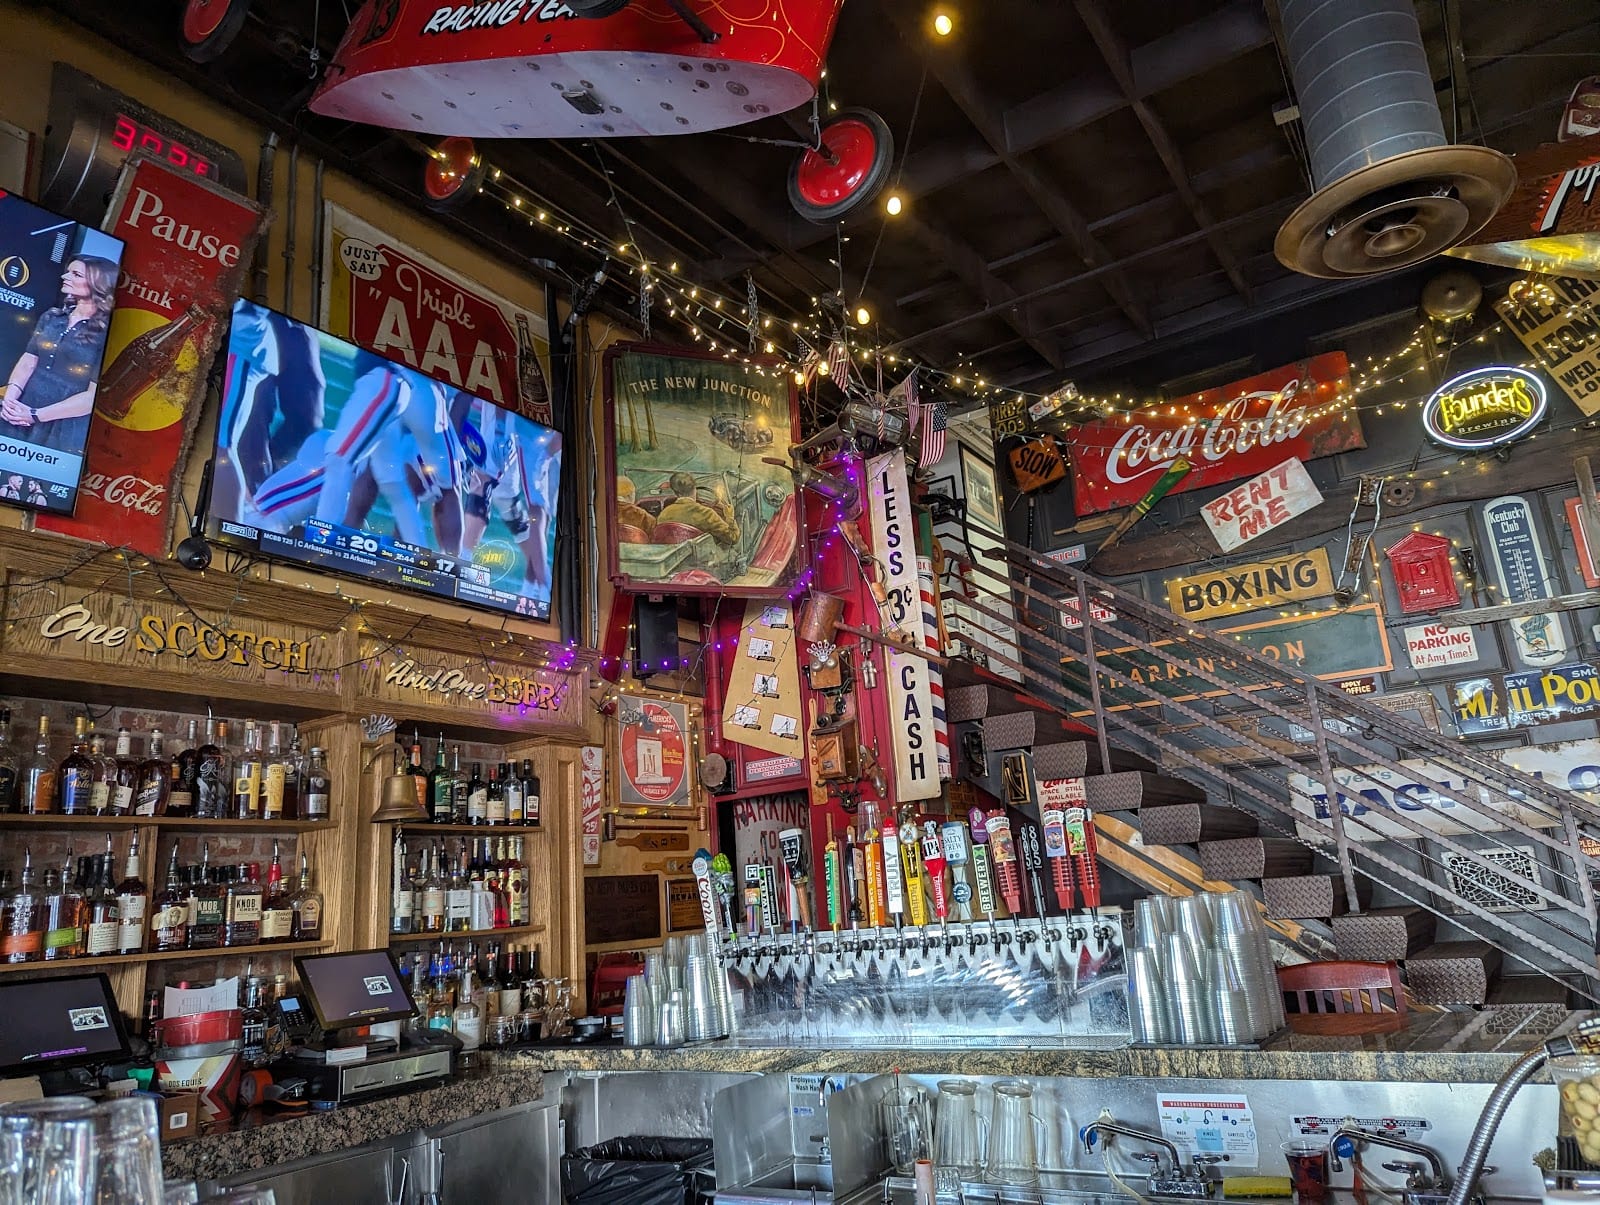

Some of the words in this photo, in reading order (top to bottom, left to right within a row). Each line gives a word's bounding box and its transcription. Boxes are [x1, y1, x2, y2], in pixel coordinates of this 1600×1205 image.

[424, 0, 524, 33] RACING
[523, 0, 578, 21] TEA
[125, 187, 240, 267] Pause
[343, 246, 380, 263] JUST
[350, 261, 377, 275] SAY
[0, 292, 35, 310] AYOFF
[396, 263, 475, 330] Triple
[629, 378, 658, 395] THE
[665, 375, 696, 389] NEW
[703, 378, 771, 408] JUNCTION
[1441, 378, 1532, 432] Founders
[0, 443, 59, 465] oodyear
[1015, 447, 1058, 480] SLOW
[80, 474, 167, 516] a-Cola
[1205, 463, 1294, 527] RENT
[309, 519, 333, 530] KANSAS
[881, 471, 904, 576] LESS
[1238, 496, 1292, 540] ME
[1488, 506, 1525, 524] Kentucky
[1500, 520, 1520, 534] Club
[304, 542, 334, 556] Arkansas
[350, 554, 377, 566] Arkansas
[350, 535, 378, 553] 20
[436, 557, 456, 572] 17
[1180, 558, 1318, 613] BOXING
[887, 585, 913, 624] 3¢
[41, 603, 128, 647] One
[136, 615, 311, 673] SCOTCH
[1408, 632, 1472, 652] PARKING
[1423, 624, 1449, 637] NO
[1415, 654, 1426, 665] At
[1427, 653, 1447, 665] Any
[1449, 645, 1473, 660] Time!
[385, 659, 438, 692] And
[438, 669, 487, 699] One
[488, 673, 560, 711] BEER
[1340, 680, 1361, 689] APPLY
[902, 665, 926, 780] CASH
[1307, 769, 1392, 788] Pyer's
[1040, 788, 1060, 796] SPACE
[1064, 785, 1083, 793] STILL
[1047, 791, 1082, 800] AVAILABLE
[733, 795, 808, 831] PARKING
[922, 841, 940, 857] IPA
[1029, 825, 1042, 866] 805
[885, 853, 901, 902] TRULY
[975, 858, 992, 911] BREWERY
[198, 900, 218, 911] KNOB
[236, 898, 256, 908] KNOB
[698, 877, 714, 927] Coors
[168, 1079, 180, 1088] DOS
[181, 1077, 202, 1088] EQUIS
[791, 1075, 816, 1083] Employees
